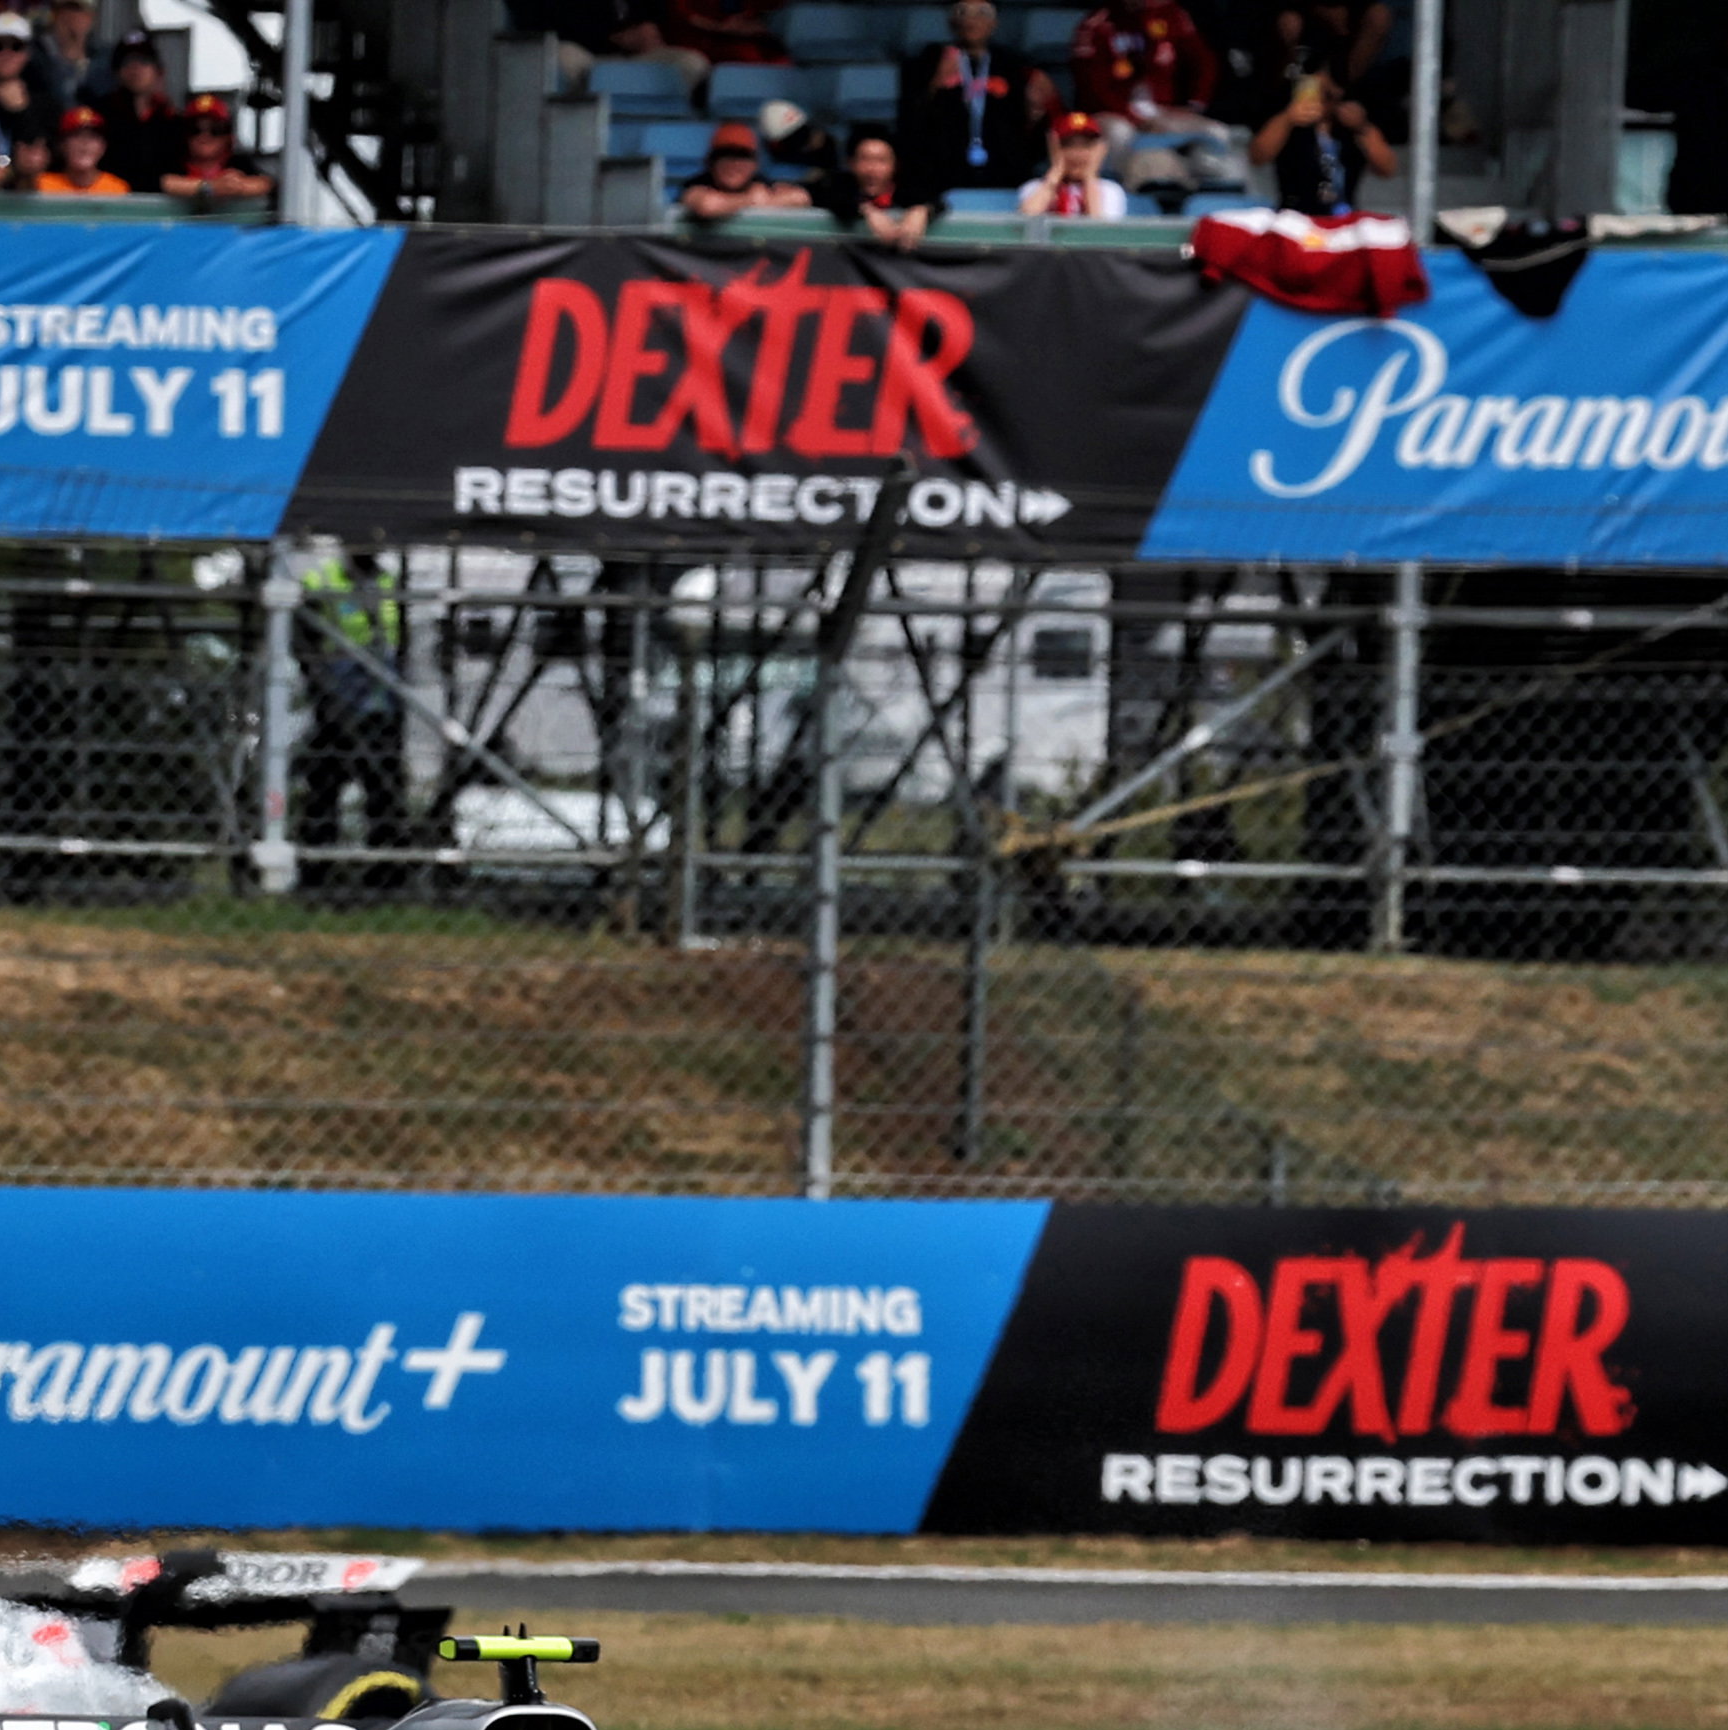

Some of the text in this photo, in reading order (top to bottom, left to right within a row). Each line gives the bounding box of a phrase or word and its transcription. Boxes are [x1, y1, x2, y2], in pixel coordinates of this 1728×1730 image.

[504, 248, 981, 459] DEXTER
[210, 368, 283, 437] 11
[453, 466, 1017, 528] RESURRECTON
[619, 1283, 922, 1336] STREAMING
[1156, 1221, 1639, 1443] DEXTER
[618, 1349, 930, 1426] JULY 11
[1101, 1453, 1675, 1507] RESURRECTION
